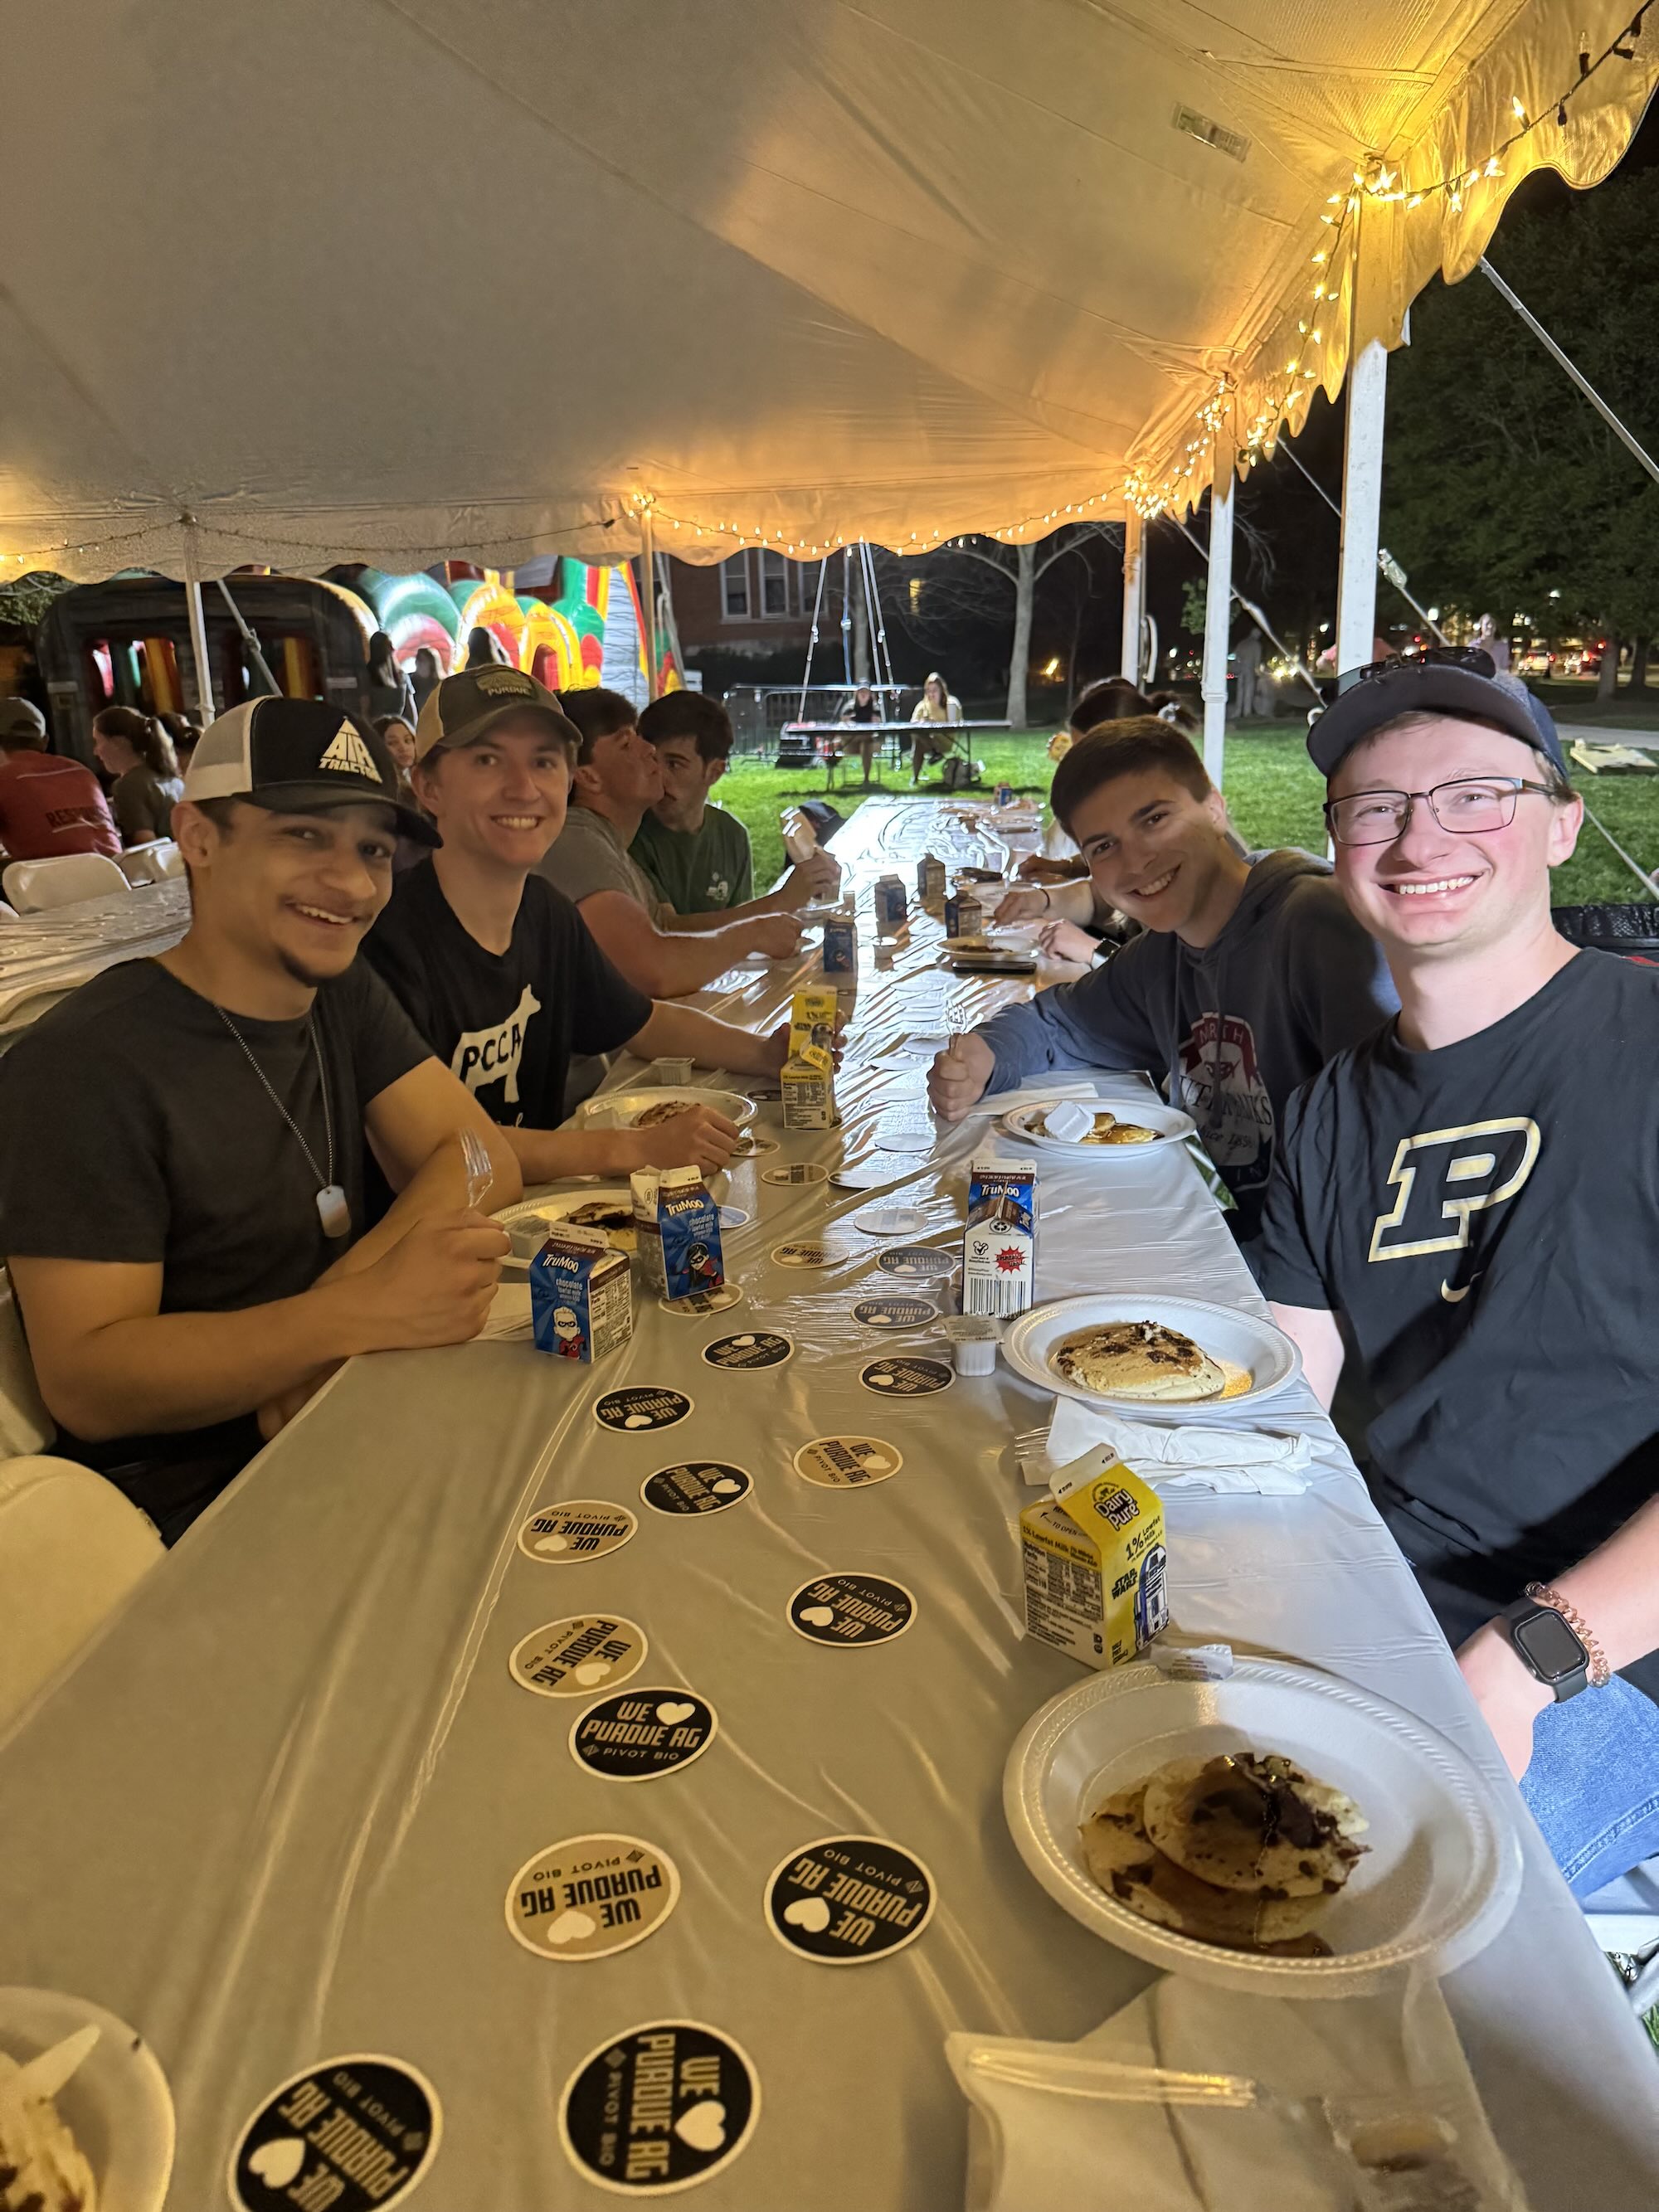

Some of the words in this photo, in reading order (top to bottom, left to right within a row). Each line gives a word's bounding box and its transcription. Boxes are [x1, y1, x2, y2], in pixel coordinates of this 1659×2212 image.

[322, 730, 377, 768] AIR
[460, 1023, 523, 1085] PCCA
[665, 1199, 704, 1217] TruMoo
[542, 1254, 579, 1273] TruMoo
[713, 1344, 740, 1355] WE
[716, 1344, 766, 1366] PURDUE
[874, 1361, 898, 1373] AG
[892, 1367, 946, 1388] PURDUE
[892, 1380, 917, 1392] WE
[600, 1407, 625, 1420] AG
[624, 1394, 684, 1414] PURDUE
[649, 1407, 678, 1420] WE
[849, 1443, 876, 1457] WE
[819, 1441, 861, 1471] PURDUE
[844, 1469, 871, 1483] AG
[698, 1467, 726, 1483] WE
[665, 1467, 710, 1500] PURDUE
[693, 1495, 722, 1510] AG
[1095, 1489, 1135, 1517] Dairy
[531, 1519, 558, 1533] AG
[558, 1520, 629, 1536] PURDUE
[1108, 1503, 1140, 1531] Pure
[1142, 1516, 1160, 1536] Lowfat
[569, 1537, 600, 1550] WE
[1126, 1533, 1144, 1561] 1%
[837, 1579, 858, 1590] BIO
[1112, 1574, 1137, 1600] WARS
[1115, 1568, 1137, 1588] STAR
[807, 1582, 840, 1602] AG
[859, 1589, 893, 1607] PIVOT
[831, 1593, 903, 1632] PURDUE
[831, 1616, 866, 1638] WE
[552, 1620, 619, 1668] PURDUE
[594, 1640, 631, 1663] WE
[531, 1665, 567, 1686] AG
[616, 1701, 654, 1722] WE
[581, 1719, 669, 1746] PURDUE
[669, 1727, 703, 1748] AG
[603, 1748, 647, 1757] PIVOT
[654, 1752, 679, 1761] BIO
[571, 1856, 620, 1874] PIVOT
[824, 1849, 851, 1865] BIO
[533, 1869, 562, 1881] BIO
[789, 1857, 830, 1891] AG
[854, 1862, 902, 1887] PIVOT
[562, 1864, 662, 1908] PURDUE
[520, 1886, 556, 1918] AG
[822, 1872, 922, 1928] PURDUE
[600, 1898, 641, 1928] WE
[829, 1910, 876, 1947] WE
[630, 2034, 676, 2134] PURDUE
[679, 2055, 721, 2098] WE
[278, 2080, 332, 2130] AG
[307, 2107, 410, 2200] PURDUE
[625, 2141, 669, 2179] AG
[287, 2162, 346, 2212] WE
